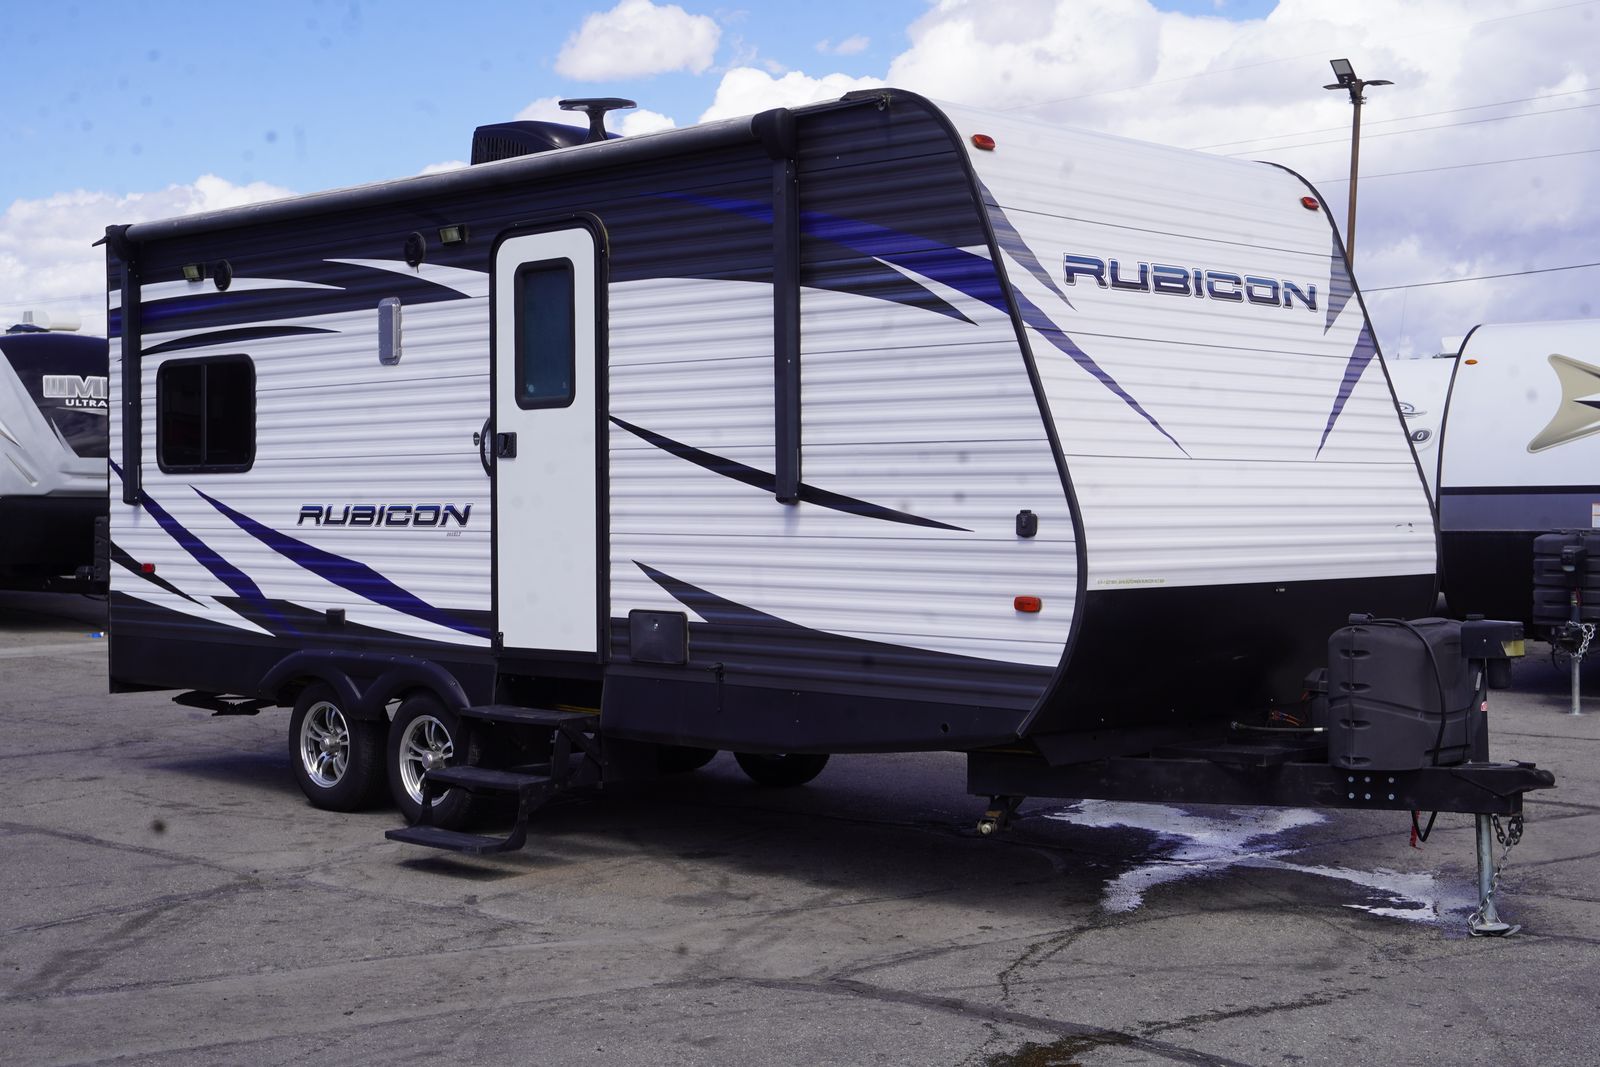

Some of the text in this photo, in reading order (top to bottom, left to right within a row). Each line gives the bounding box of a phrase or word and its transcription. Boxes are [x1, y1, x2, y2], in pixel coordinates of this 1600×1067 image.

[1063, 252, 1319, 312] RUBICON
[65, 398, 108, 408] ULTRA
[297, 502, 474, 527] RUBICON
